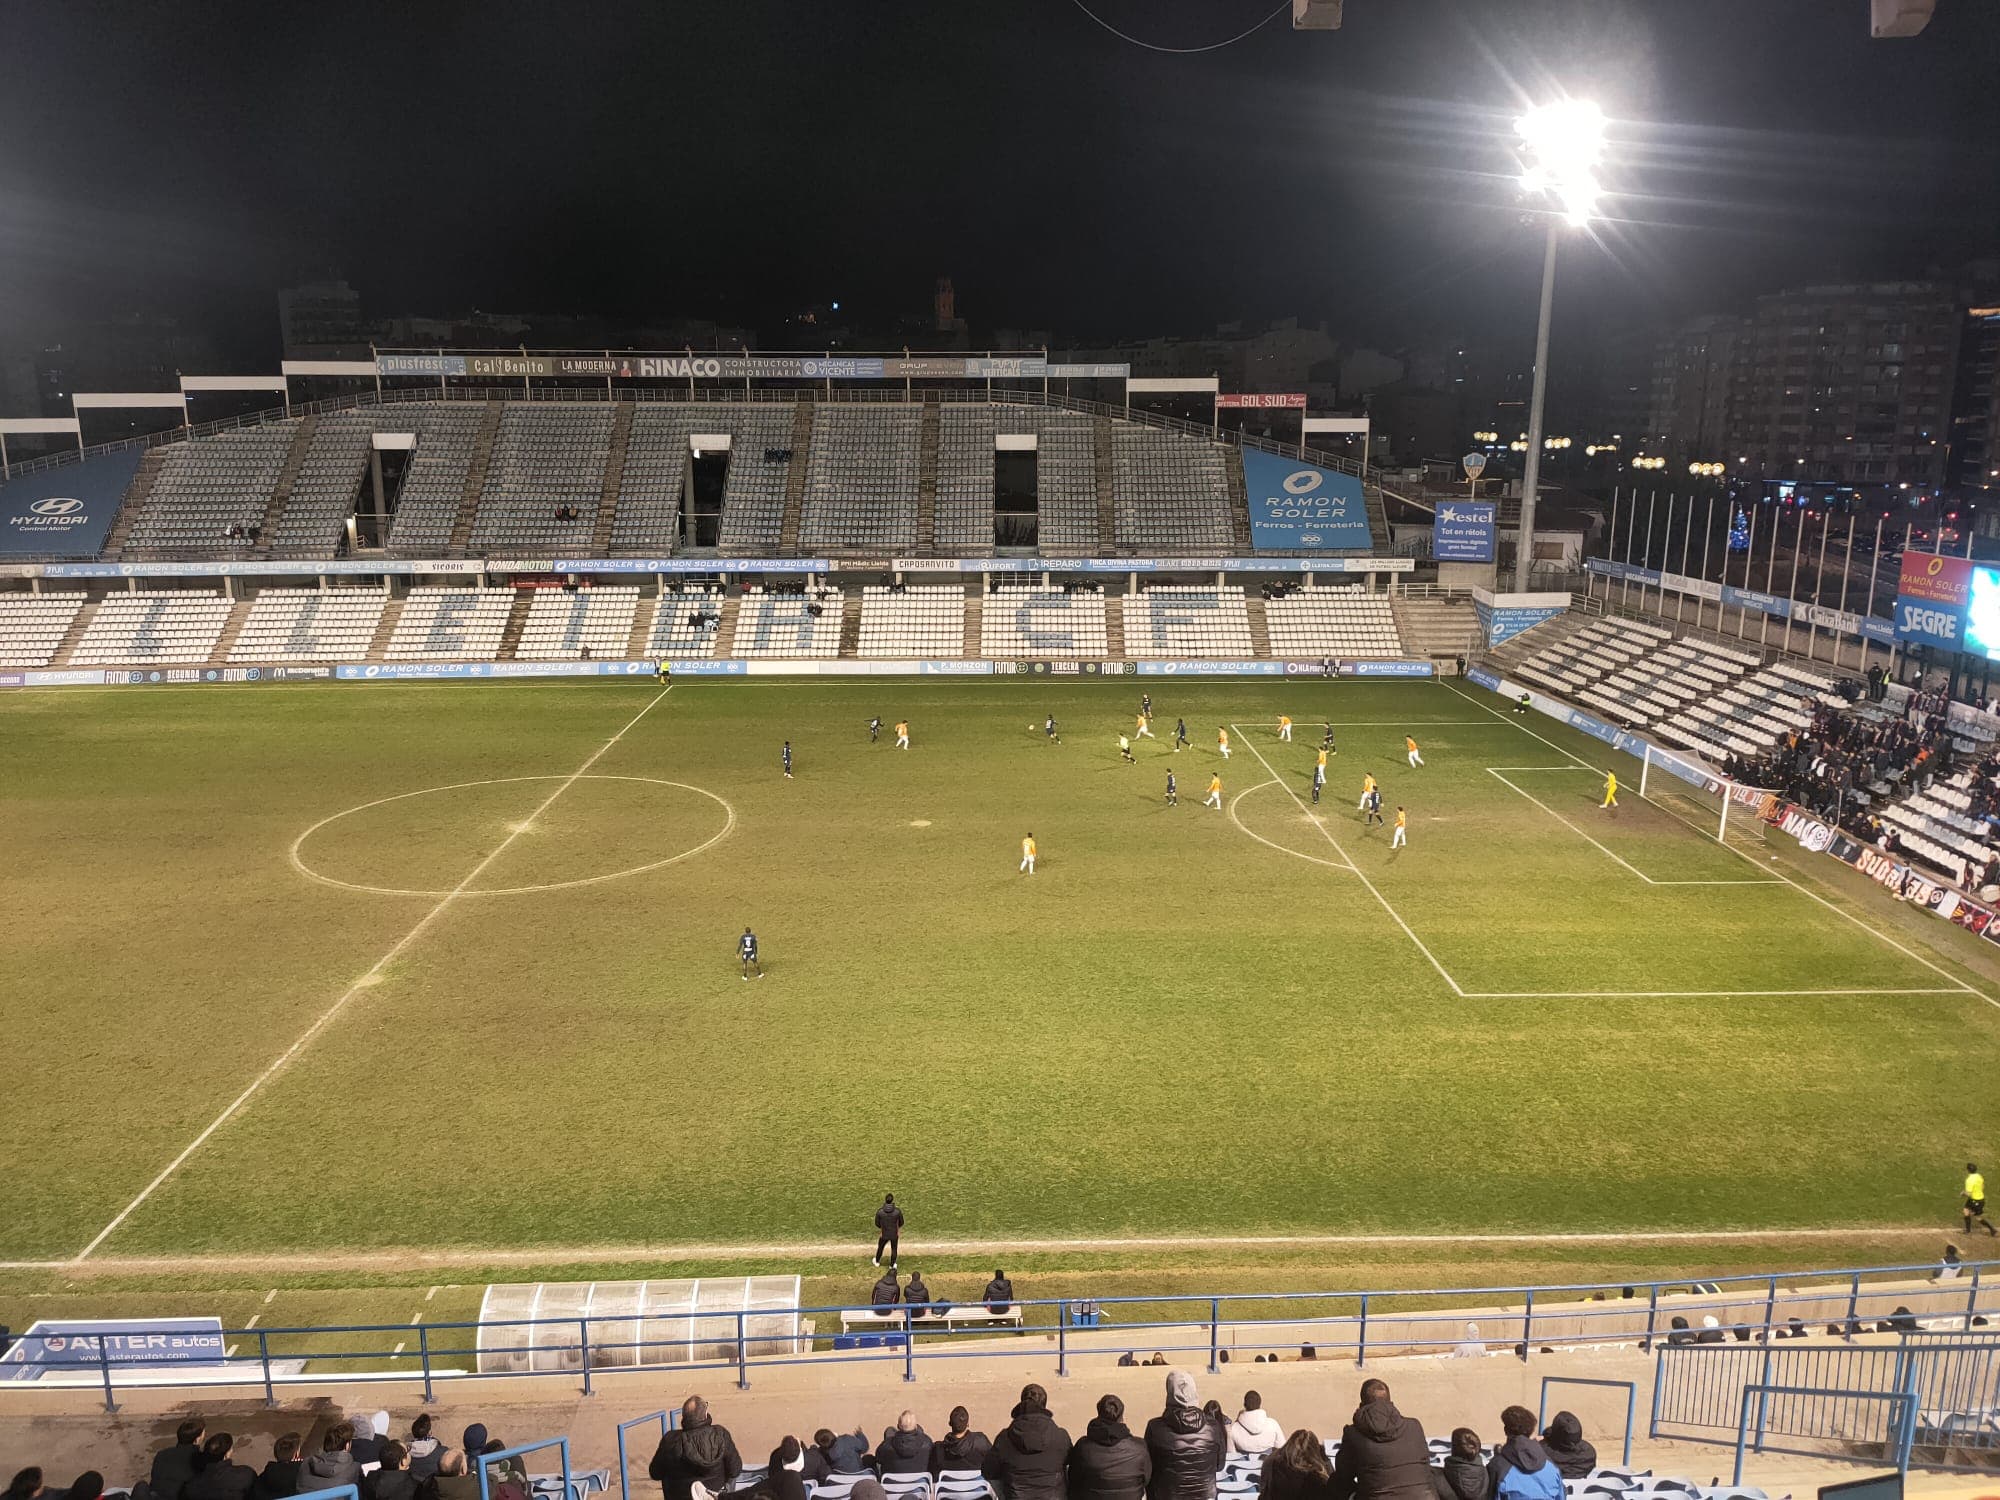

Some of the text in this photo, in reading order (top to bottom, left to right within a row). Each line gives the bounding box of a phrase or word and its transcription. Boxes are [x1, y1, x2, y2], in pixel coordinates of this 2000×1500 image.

[474, 359, 495, 373] Cal
[504, 359, 544, 373] Benito
[561, 360, 617, 371] LA MODERNA
[724, 360, 802, 368] CONSTRUCTORA
[725, 369, 802, 377] INMOBILIARIA
[819, 367, 856, 376] VICENTE
[1241, 395, 1287, 408] GOL-SUD
[1265, 497, 1347, 507] RAMON
[1270, 508, 1346, 518] SOLER
[1456, 511, 1493, 523] estel
[9, 516, 88, 525] HYUNDAI
[1255, 521, 1295, 531] Ferros
[1305, 521, 1365, 531] Ferreteria
[1441, 527, 1453, 536] Tot
[567, 560, 633, 568] RAMON SOLER
[899, 560, 955, 569] CAPOSANVITO
[1901, 573, 1969, 595] RAMON SOLER
[1808, 606, 1859, 637] CaixaBank
[1899, 605, 1958, 640] SEGRE
[381, 663, 464, 673] RAMON SOLER
[492, 663, 574, 672] RAMON SOLER
[683, 661, 722, 670] SOLER
[1051, 661, 1080, 671] TERCERA
[1179, 662, 1218, 670] RAMON
[1221, 661, 1257, 670] SOLER
[167, 669, 200, 679] SEGUNDA
[70, 1333, 221, 1351] ASTER autos
